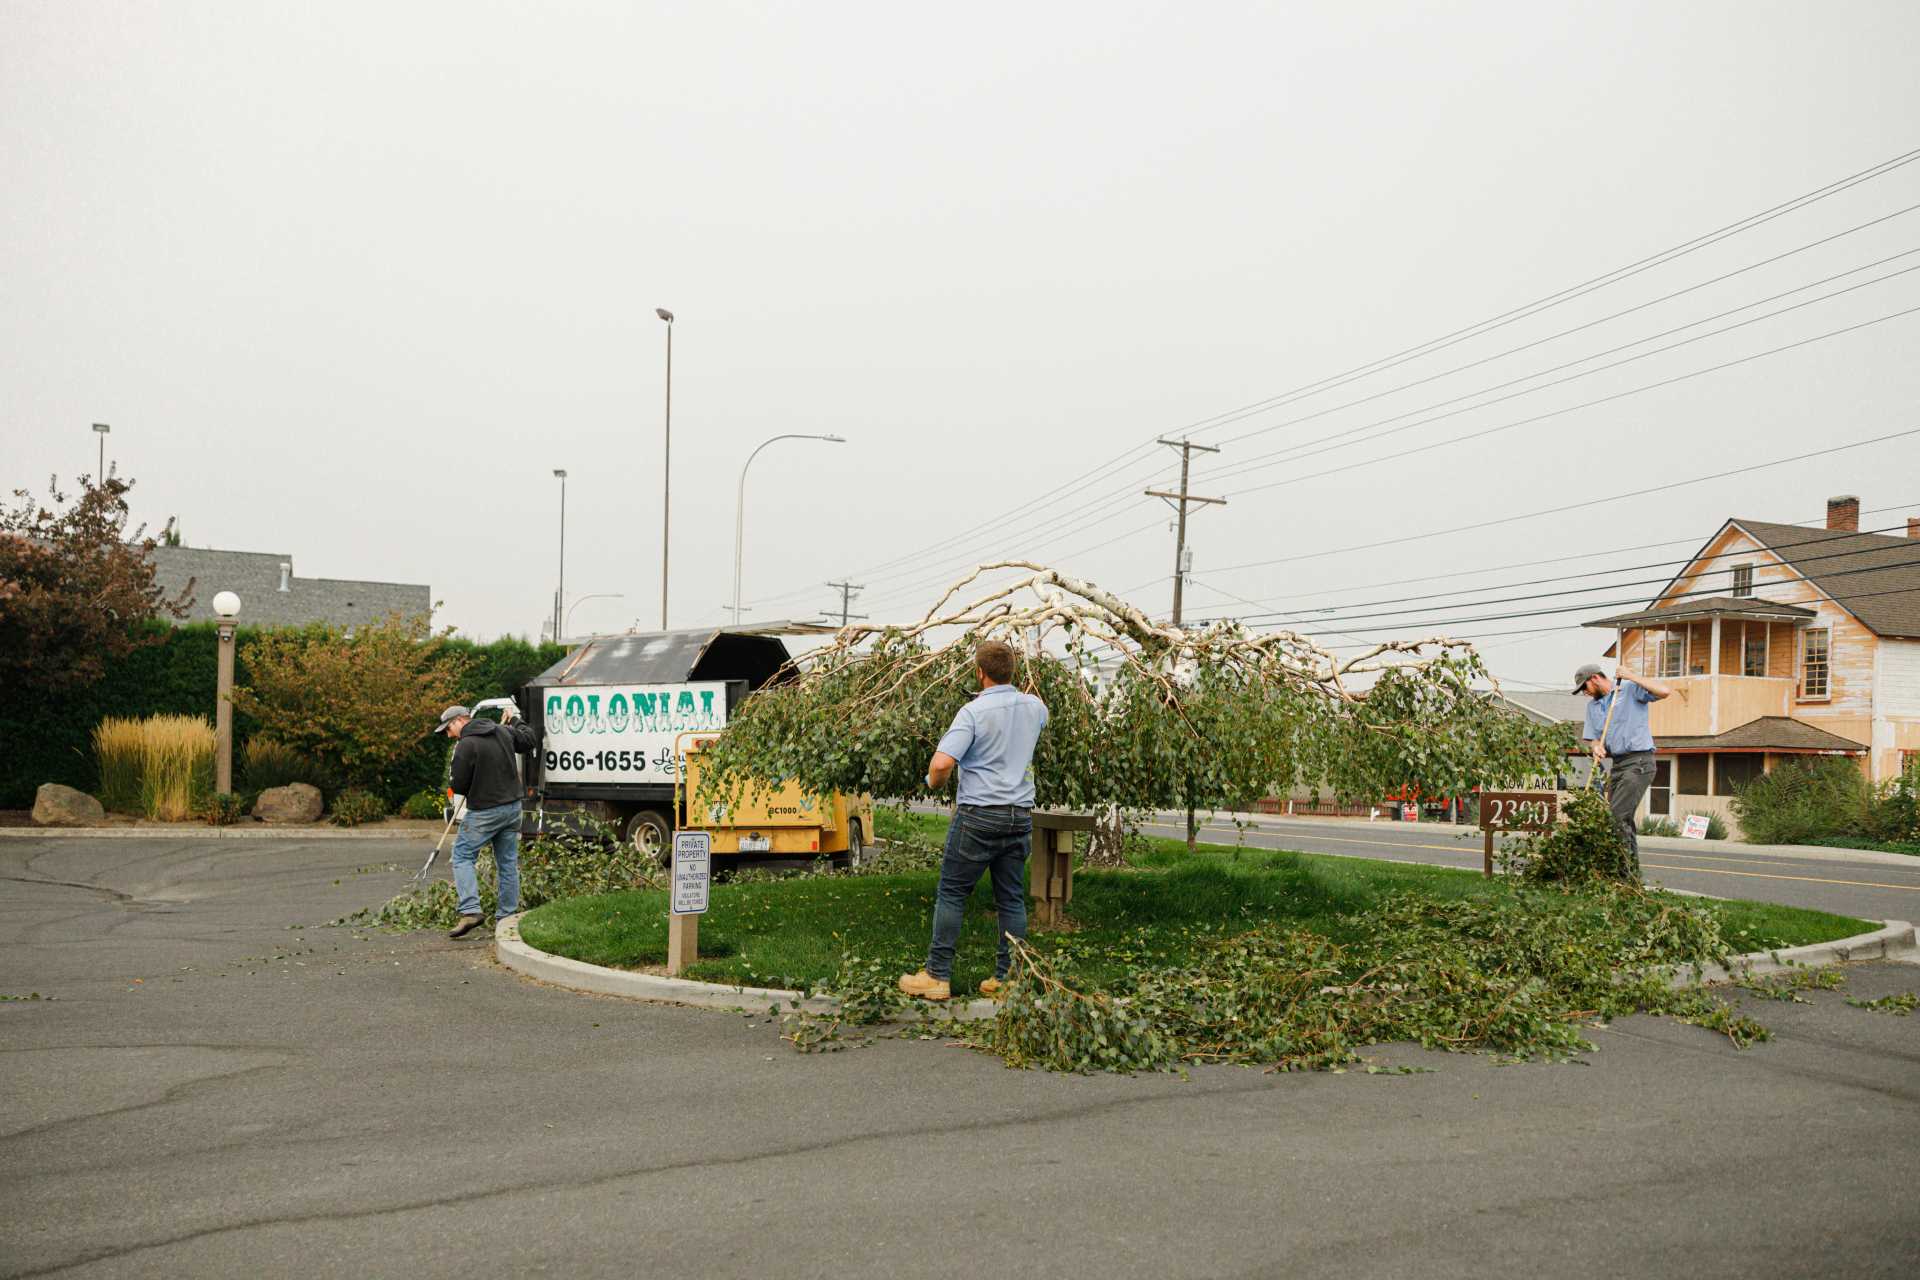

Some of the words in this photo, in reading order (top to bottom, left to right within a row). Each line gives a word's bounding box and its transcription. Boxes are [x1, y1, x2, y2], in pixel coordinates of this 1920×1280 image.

[546, 690, 721, 735] COLONIAL
[546, 750, 646, 771] 966-1655
[681, 840, 704, 849] PRIVATE
[677, 849, 706, 859] PROPERTY
[689, 863, 697, 871] NO
[676, 872, 707, 881] UNAUTHORIZED
[682, 882, 702, 890] PARKING
